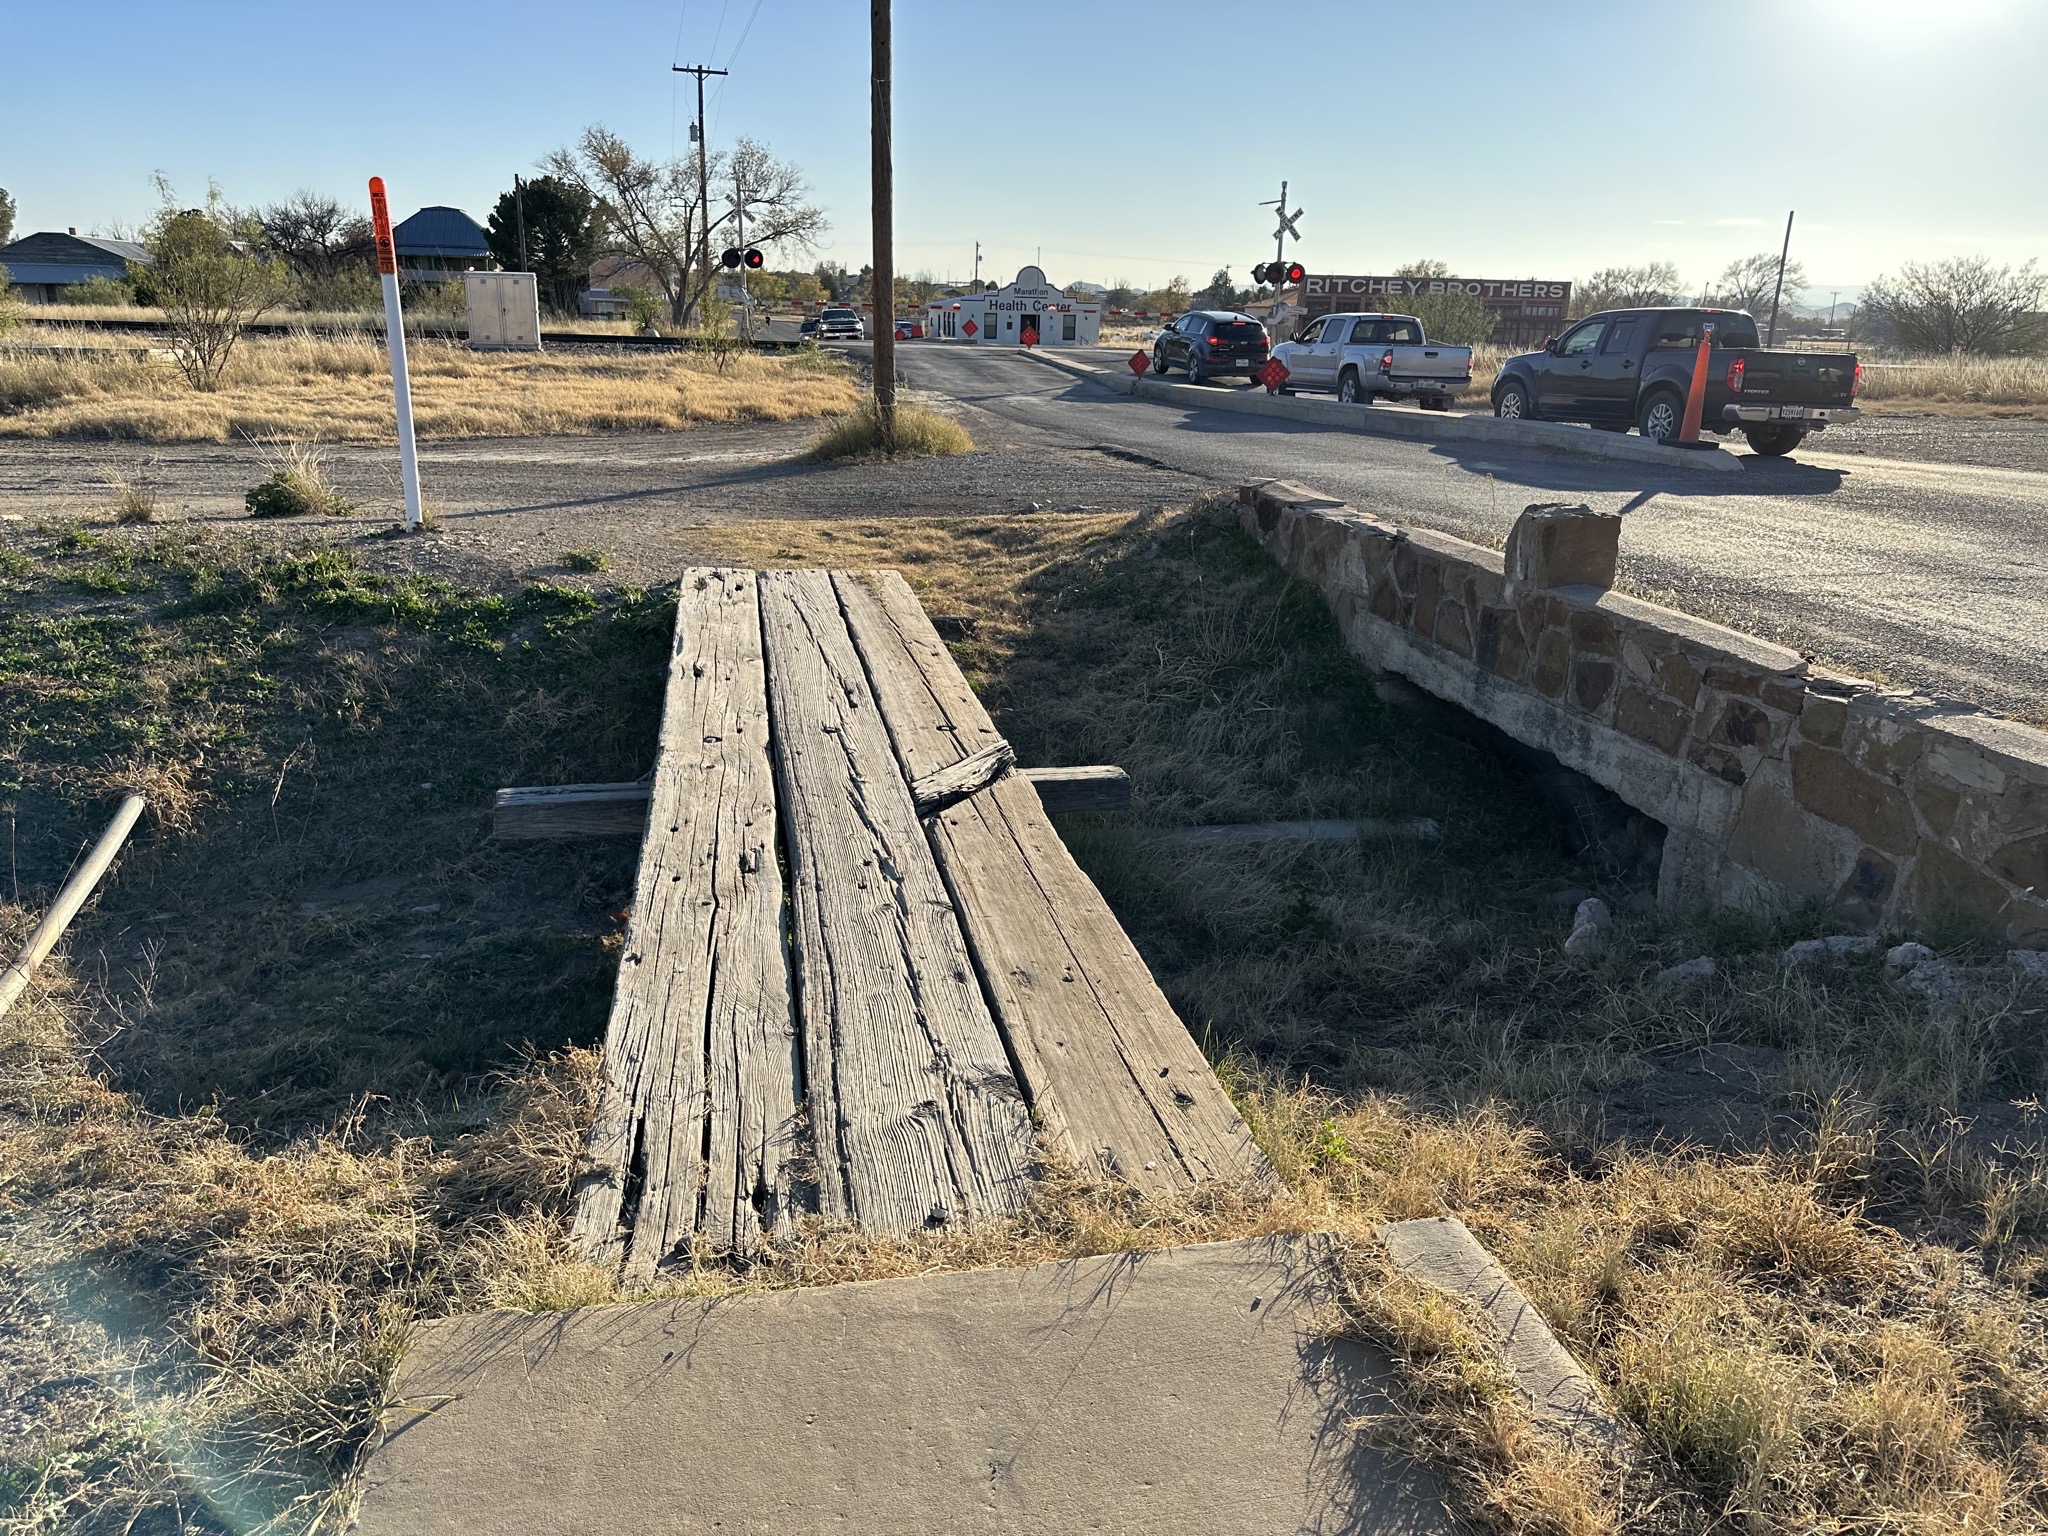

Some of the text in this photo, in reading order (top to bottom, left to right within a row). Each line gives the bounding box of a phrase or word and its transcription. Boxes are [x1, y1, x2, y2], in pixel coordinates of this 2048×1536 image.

[1013, 287, 1049, 296] Marathon
[1305, 278, 1422, 294] RITCHEY
[1429, 281, 1564, 298] BROTHERS
[989, 299, 1027, 312] Health
